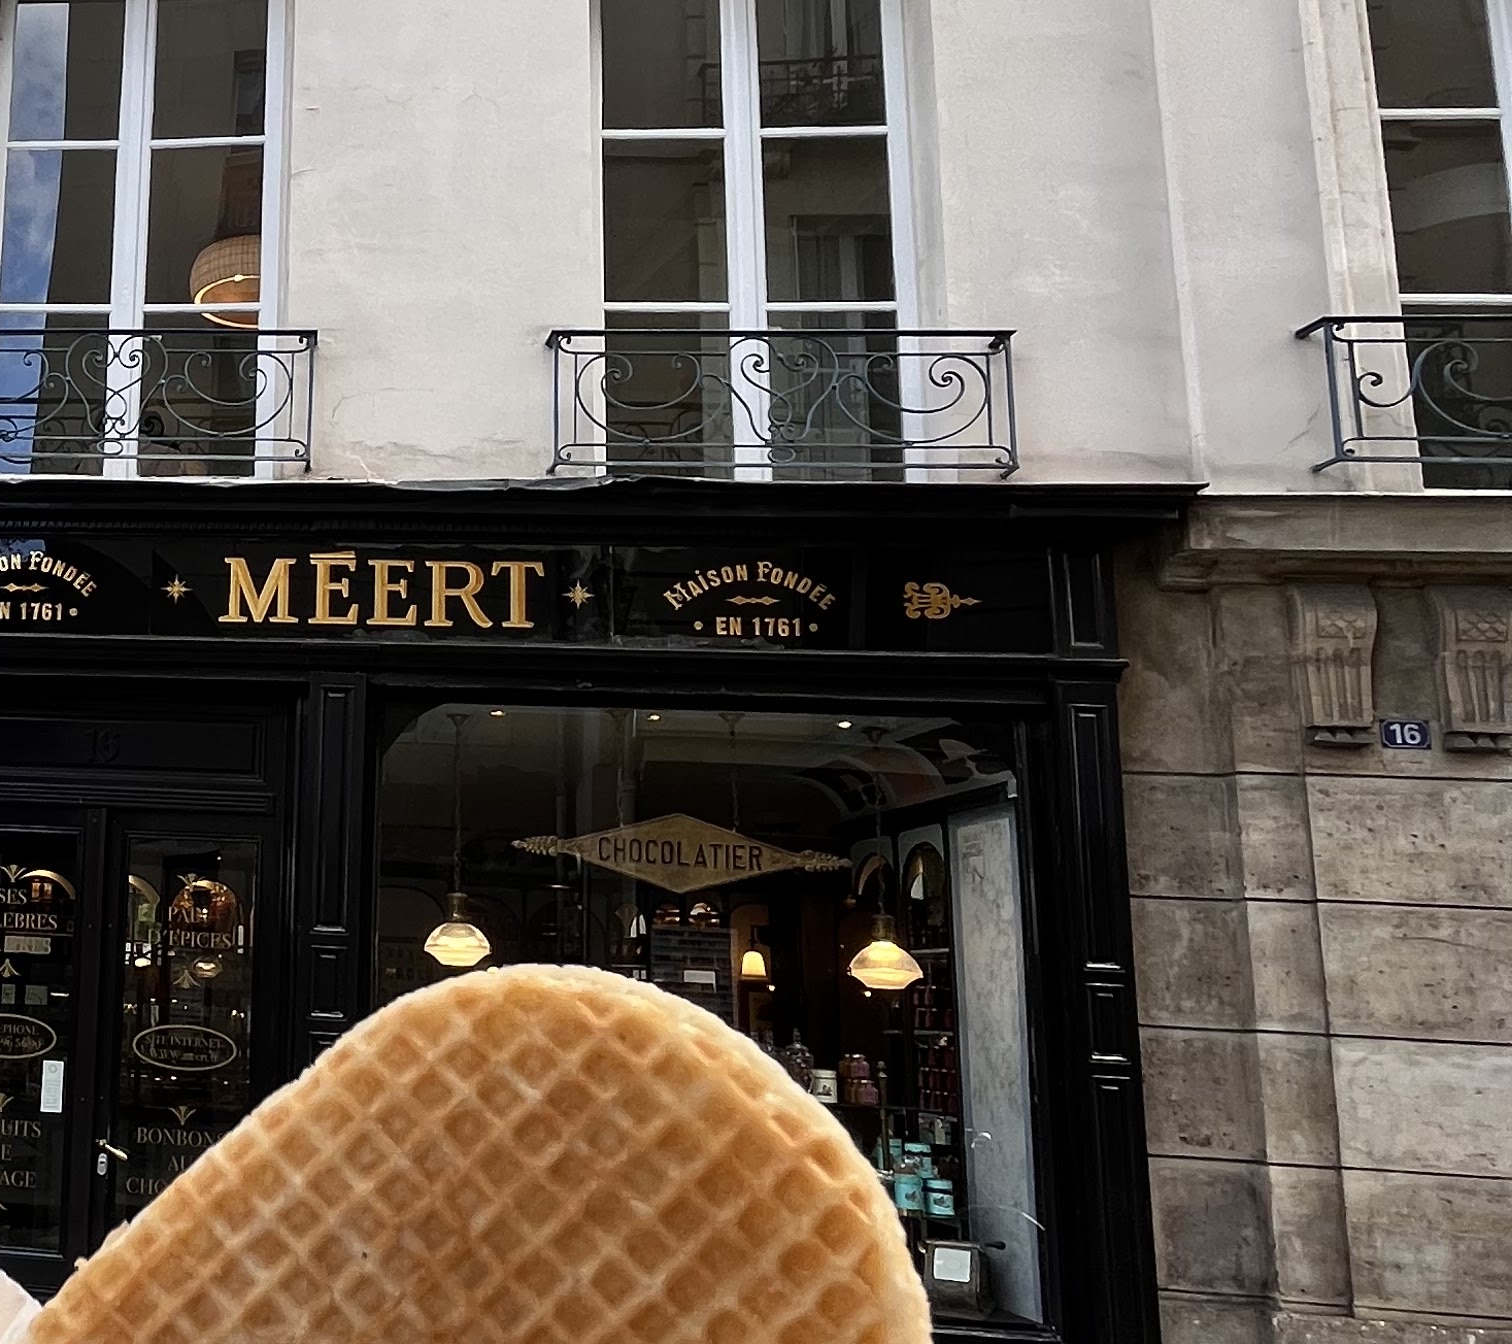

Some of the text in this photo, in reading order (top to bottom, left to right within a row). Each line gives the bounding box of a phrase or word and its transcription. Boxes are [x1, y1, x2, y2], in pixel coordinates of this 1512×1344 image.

[20, 602, 62, 621] 1761
[715, 616, 801, 637] EN 1761
[1389, 723, 1421, 744] 16
[598, 837, 763, 871] CHOCOLATIER
